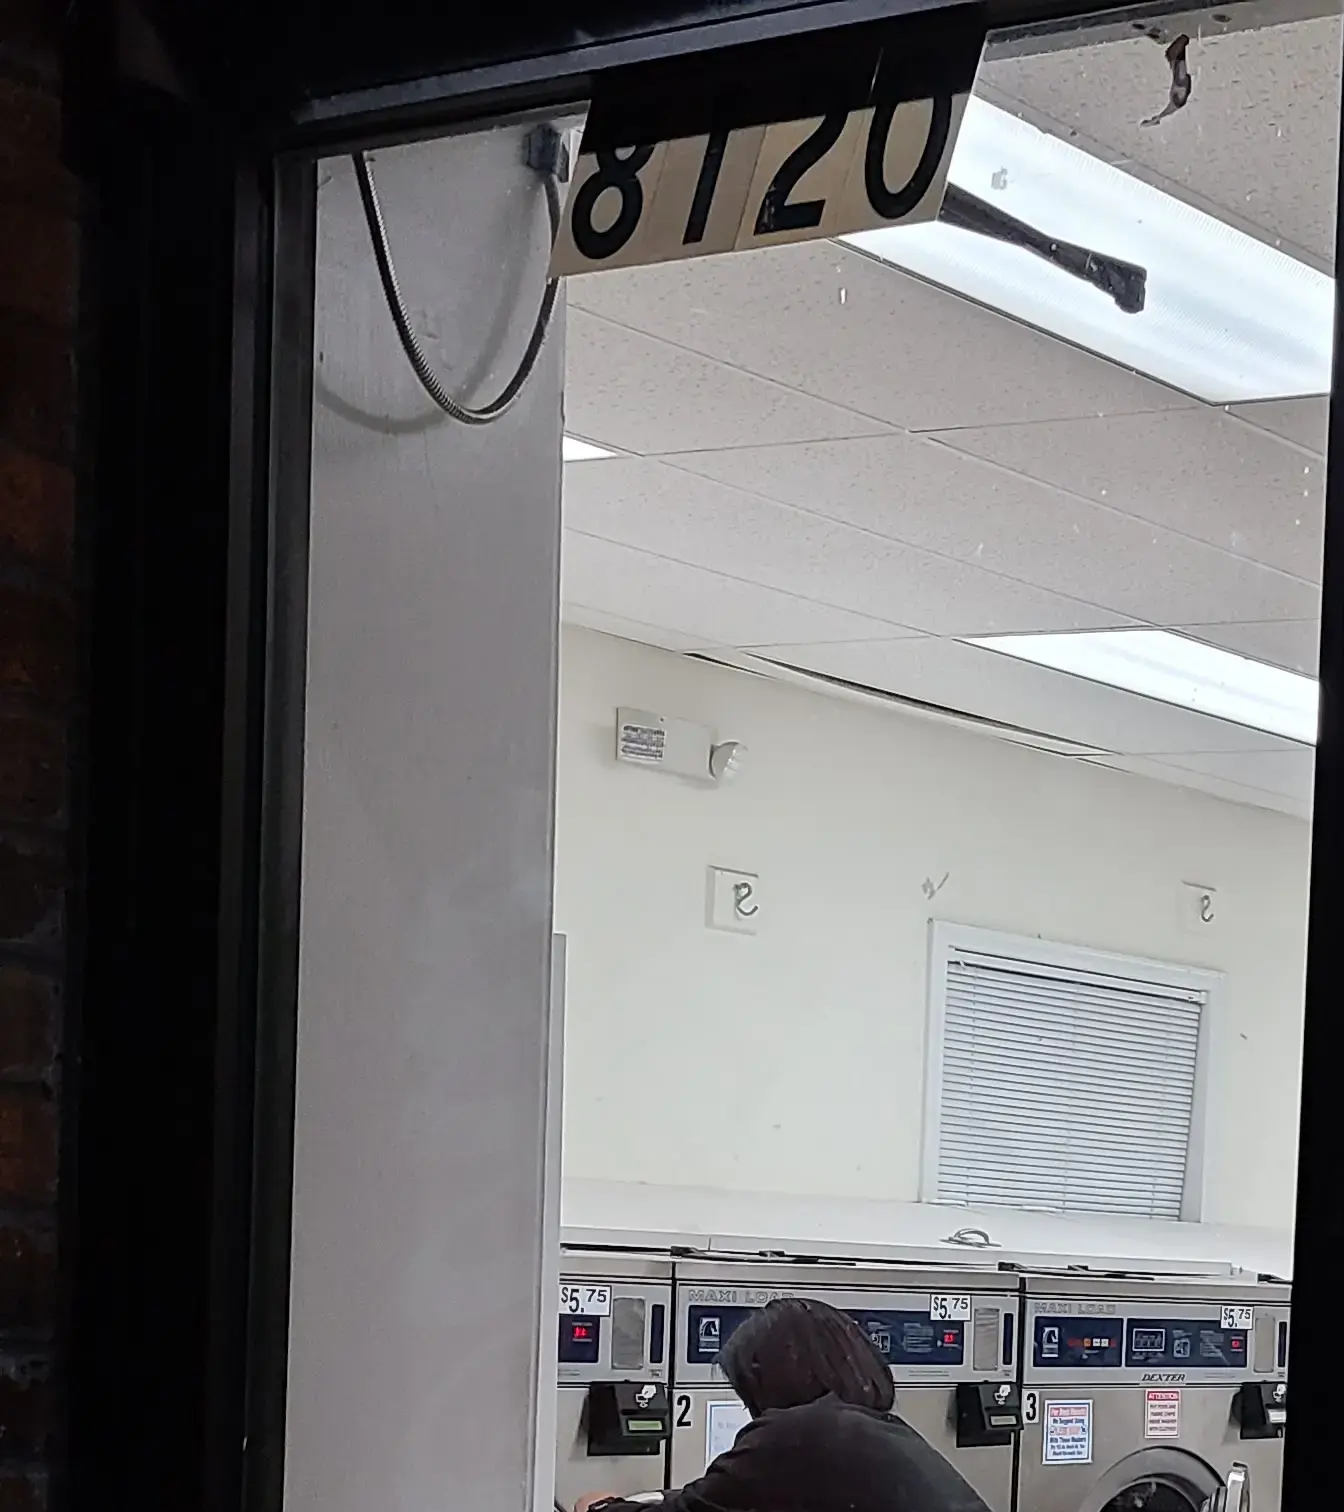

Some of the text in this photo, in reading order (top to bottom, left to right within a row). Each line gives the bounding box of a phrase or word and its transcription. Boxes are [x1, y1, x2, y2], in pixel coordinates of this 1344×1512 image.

[560, 1288, 608, 1314] $5.75
[688, 1289, 737, 1302] MAXI
[933, 1296, 969, 1319] $5.75
[1223, 1308, 1251, 1328] $5.75
[1141, 1373, 1186, 1382] DEXTER
[676, 1395, 692, 1428] 2
[1026, 1393, 1037, 1421] 3
